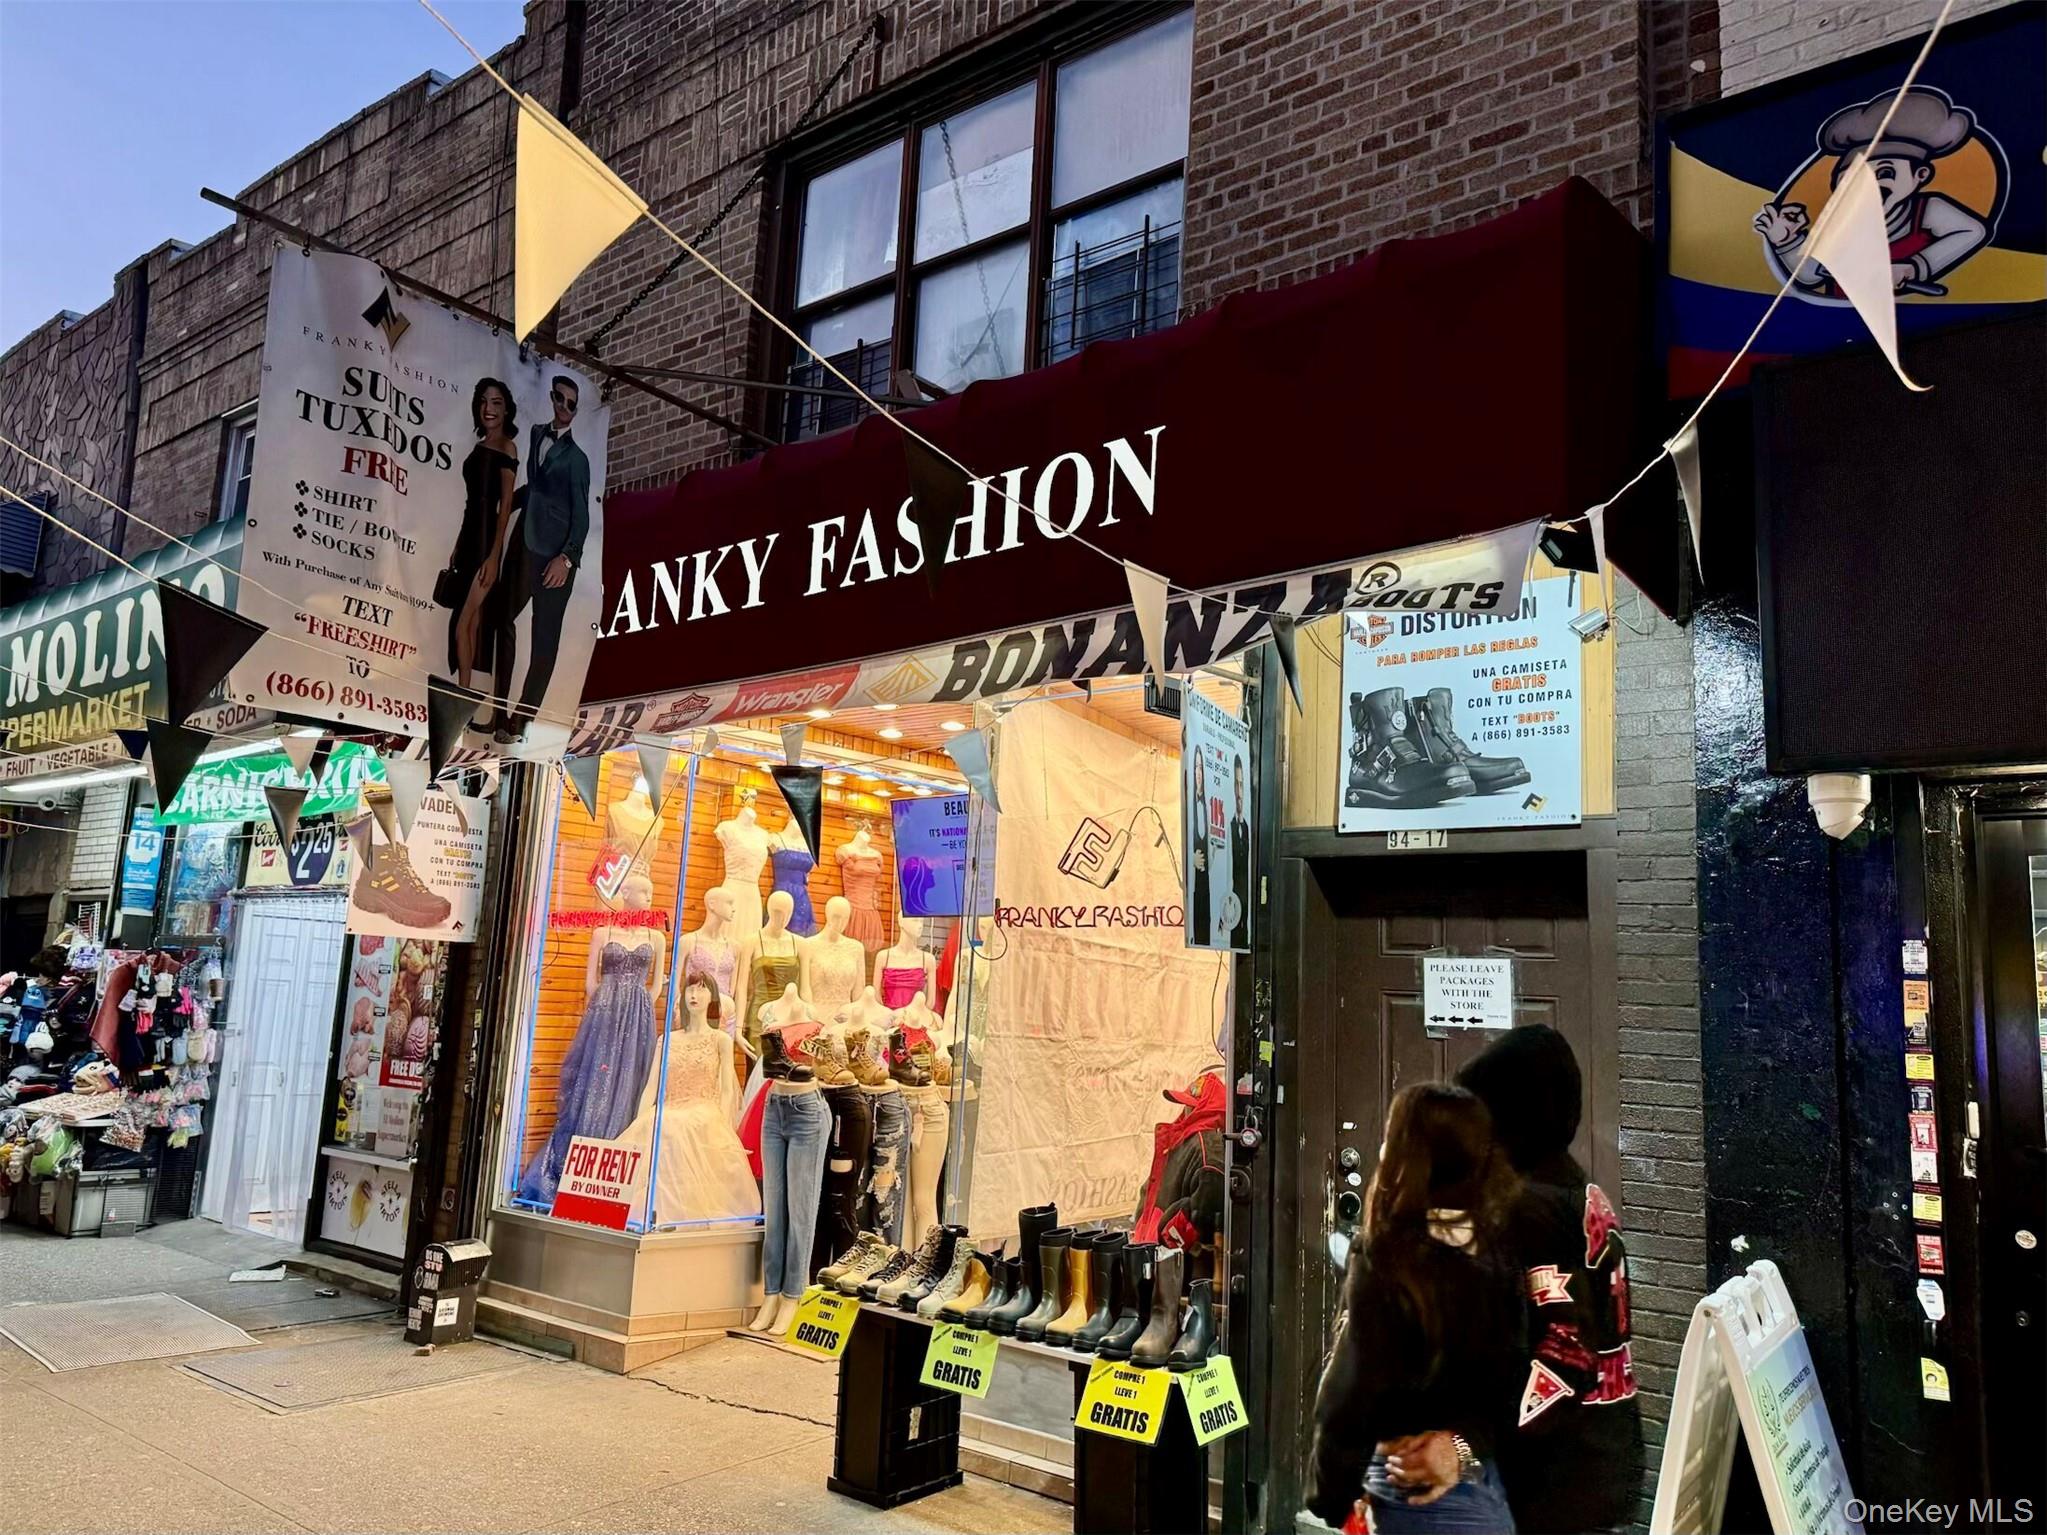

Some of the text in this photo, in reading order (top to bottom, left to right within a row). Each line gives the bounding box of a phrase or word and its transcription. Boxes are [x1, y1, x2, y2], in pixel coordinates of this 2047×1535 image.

[303, 326, 386, 356] FRANKY
[313, 486, 377, 513] SHIRT
[312, 507, 345, 530] TIE
[311, 530, 375, 561] SOCKS
[262, 551, 291, 567] With
[295, 558, 347, 582] Purchase
[350, 577, 361, 586] of
[363, 580, 383, 594] Any
[597, 532, 780, 638] ANKY
[341, 595, 393, 627] TEXT
[1377, 636, 1539, 667] PARA ROMPER LAS REGLAS
[345, 655, 370, 679] TO
[1473, 659, 1567, 679] UNA CAMISETA
[1492, 674, 1547, 692] GRATIS
[266, 670, 335, 706] (866)
[340, 686, 428, 723] 891-3583
[735, 682, 845, 713] Wrangler
[1468, 689, 1572, 709] CON TU COMPRA
[217, 704, 257, 730] SODA
[1482, 716, 1508, 727] TEXT
[1483, 729, 1511, 742] (866)
[1516, 724, 1570, 738] 891-3583
[6, 757, 36, 777] FRUIT
[46, 742, 109, 771] VEGETABLE
[1388, 830, 1446, 849] 94-17
[457, 859, 483, 869] COMPRA
[1430, 964, 1504, 973] PLEASE LEAVE
[1440, 976, 1494, 985] PACKAGES
[1442, 989, 1493, 998] WITH THE
[1450, 1001, 1484, 1010] STORE
[390, 1060, 409, 1076] FREE
[565, 1144, 641, 1185] FOR RENT
[571, 1181, 620, 1199] BY OWNER
[820, 1297, 839, 1309] COMPRE
[796, 1321, 840, 1350] GRATIS
[953, 1330, 975, 1343] COMPRE
[953, 1345, 968, 1357] LLEVE
[933, 1359, 982, 1390] GRATIS
[1114, 1370, 1141, 1383] COMPRE
[1196, 1369, 1215, 1383] COMPRE
[1115, 1386, 1132, 1398] LLEVE
[1090, 1401, 1149, 1434] GRATIS
[1200, 1400, 1238, 1434] GRATIS
